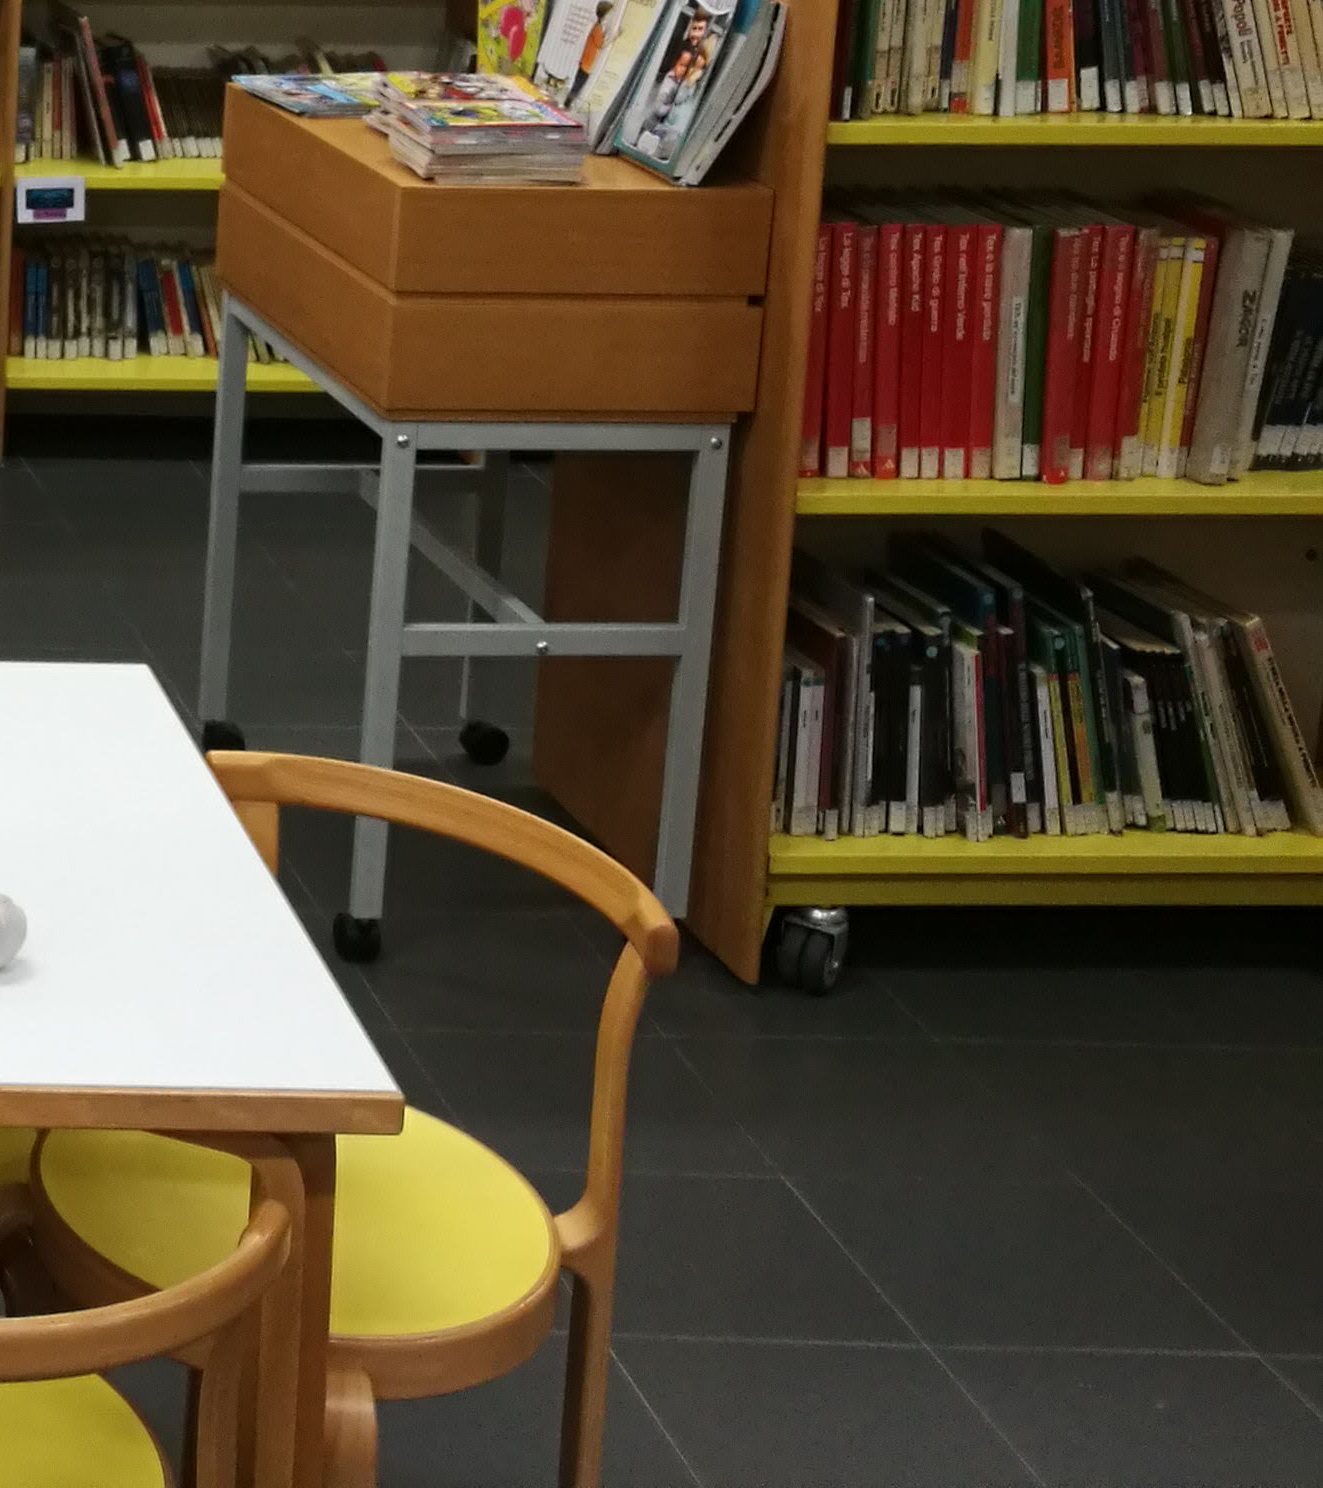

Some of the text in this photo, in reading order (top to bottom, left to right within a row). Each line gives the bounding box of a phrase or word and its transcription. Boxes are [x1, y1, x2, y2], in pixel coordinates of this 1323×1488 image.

[891, 232, 900, 251] Tex
[913, 232, 923, 252] Tex
[933, 234, 943, 254] Tex
[959, 233, 970, 252] Tex
[985, 233, 997, 253] Tex
[840, 290, 852, 309] Tex
[928, 298, 939, 333] guerra
[1235, 288, 1257, 349] ZAGOR
